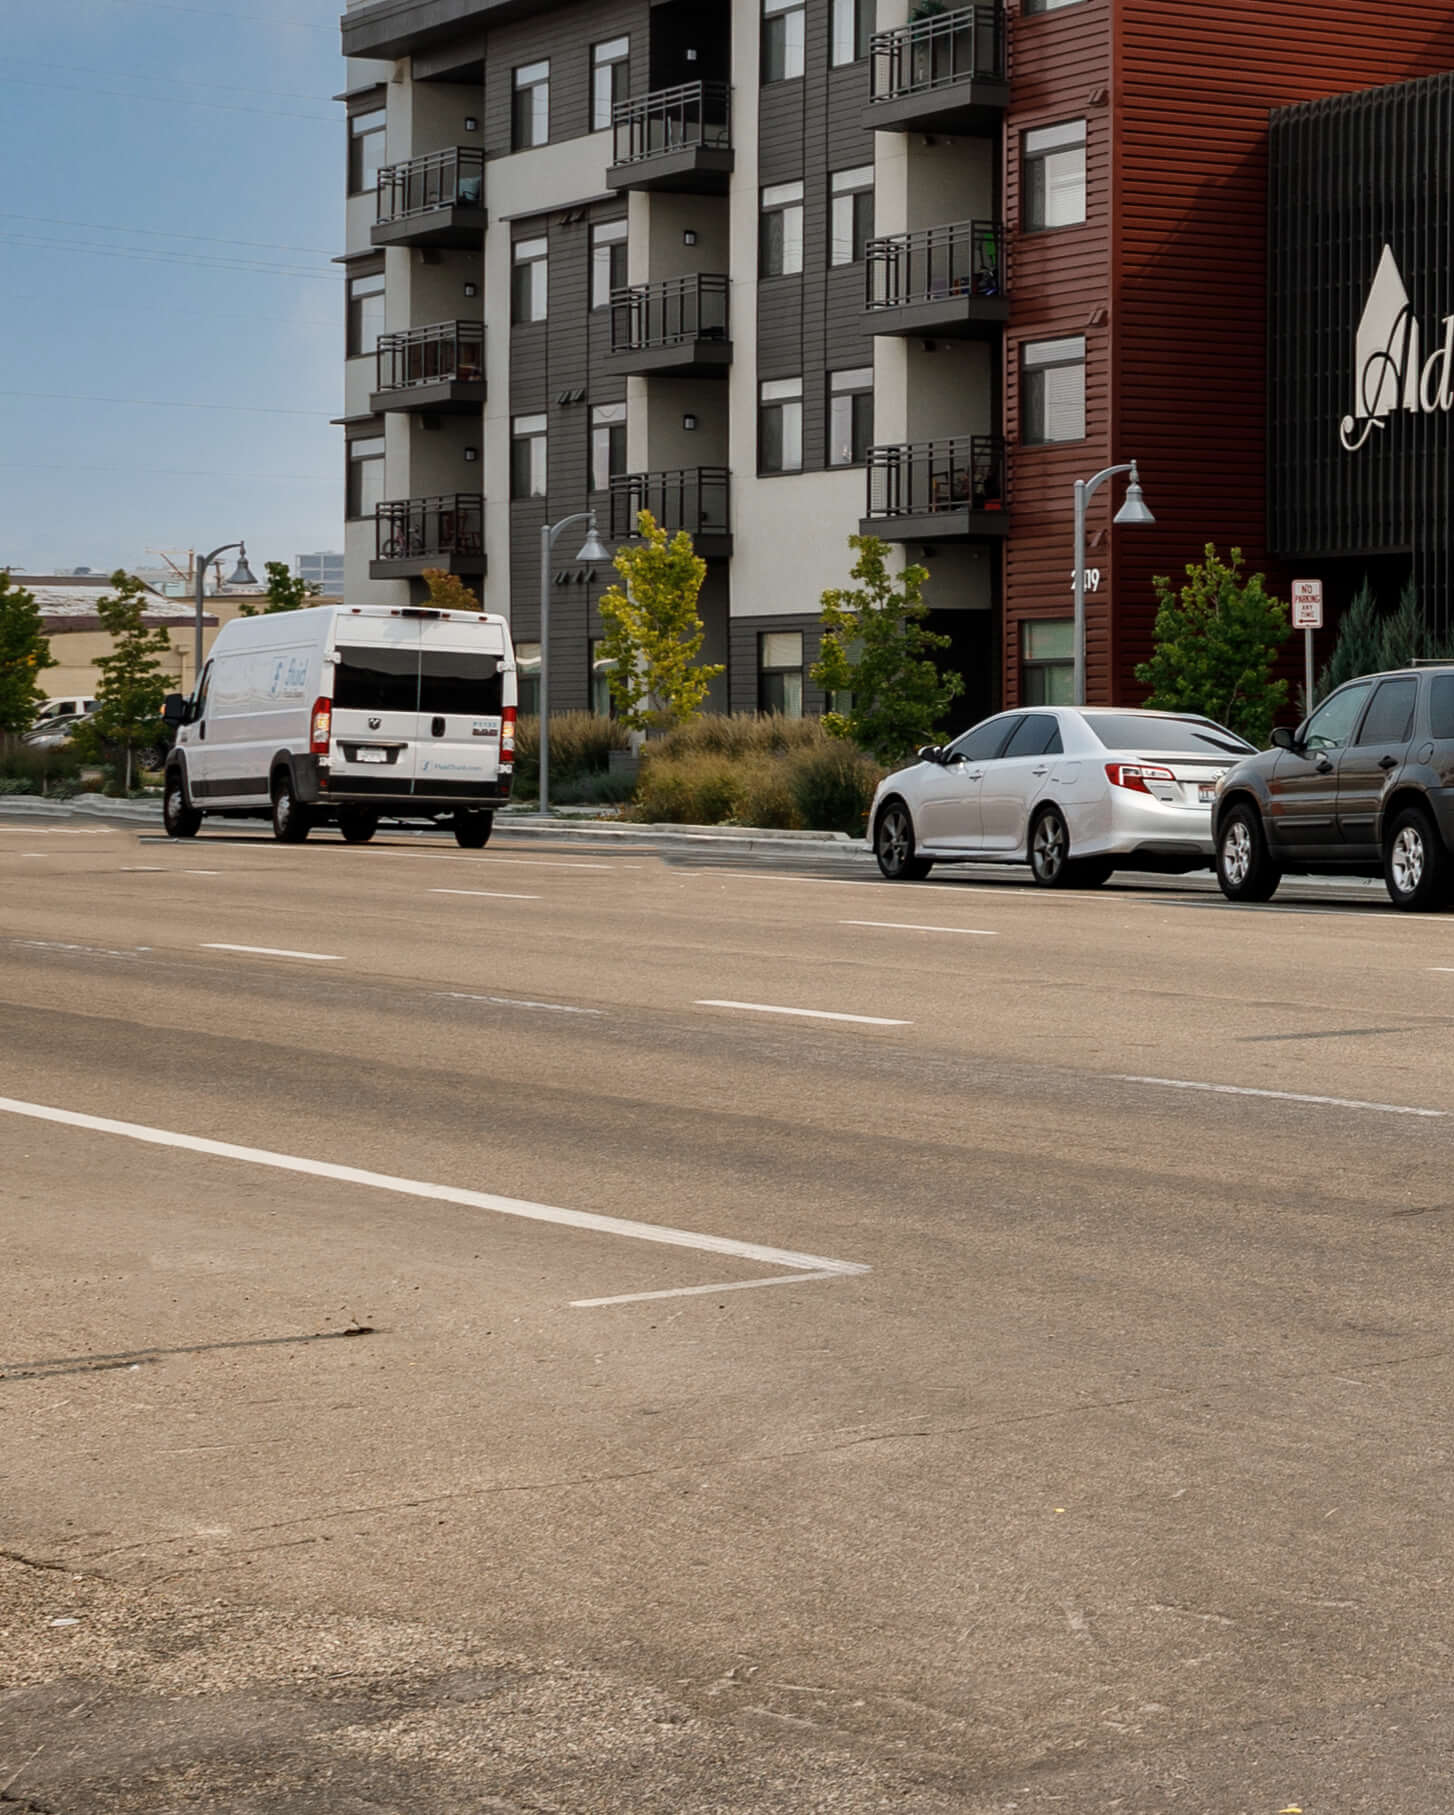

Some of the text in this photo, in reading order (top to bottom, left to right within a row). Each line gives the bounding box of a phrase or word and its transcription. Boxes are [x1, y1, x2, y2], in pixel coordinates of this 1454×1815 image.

[1070, 568, 1100, 592] 219
[1302, 584, 1313, 594] NO
[1295, 595, 1320, 603] PARKING
